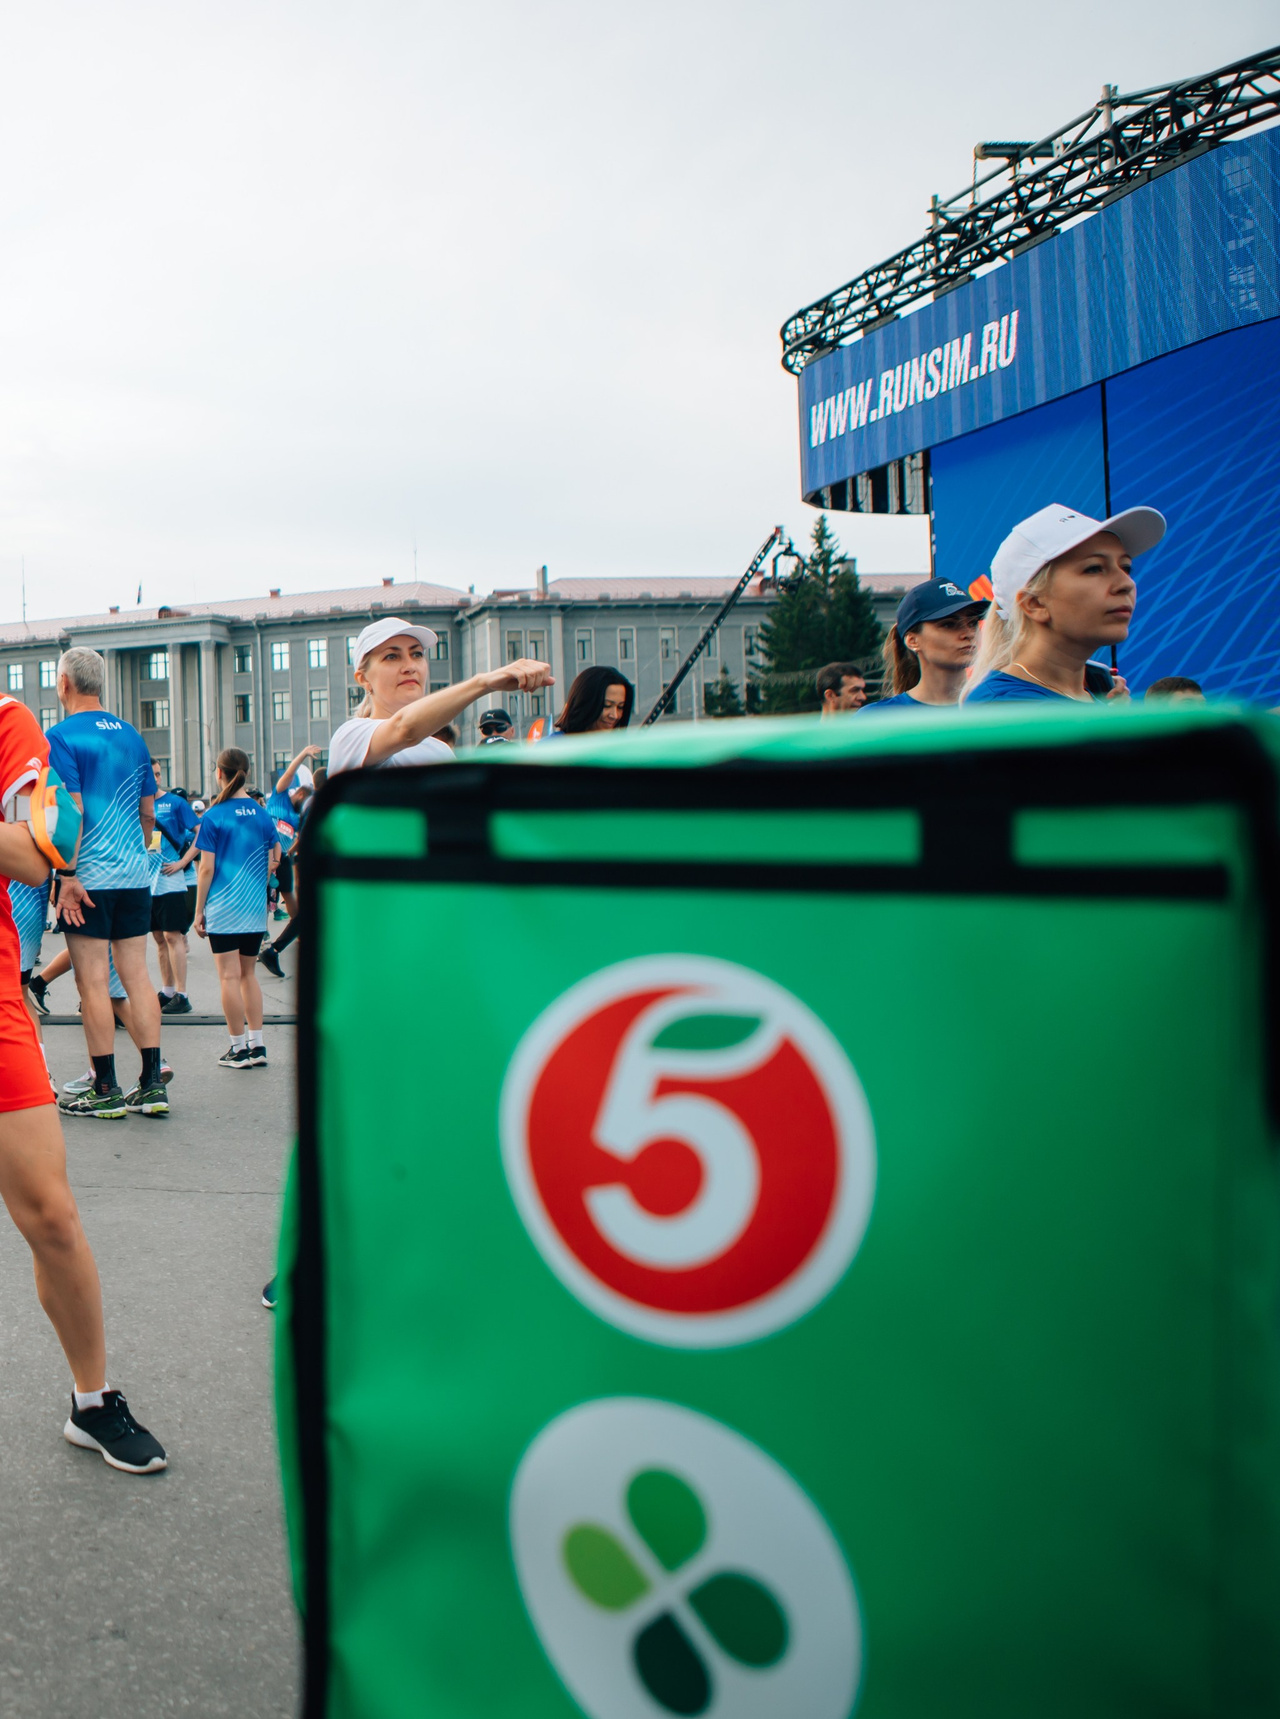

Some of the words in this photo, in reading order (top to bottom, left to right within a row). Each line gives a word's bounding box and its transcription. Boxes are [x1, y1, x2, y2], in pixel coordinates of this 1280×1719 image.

[810, 309, 1019, 449] WWW.RUNSIM.RU
[95, 718, 123, 730] SIM
[235, 805, 256, 816] SIM
[583, 1000, 772, 1273] 5
